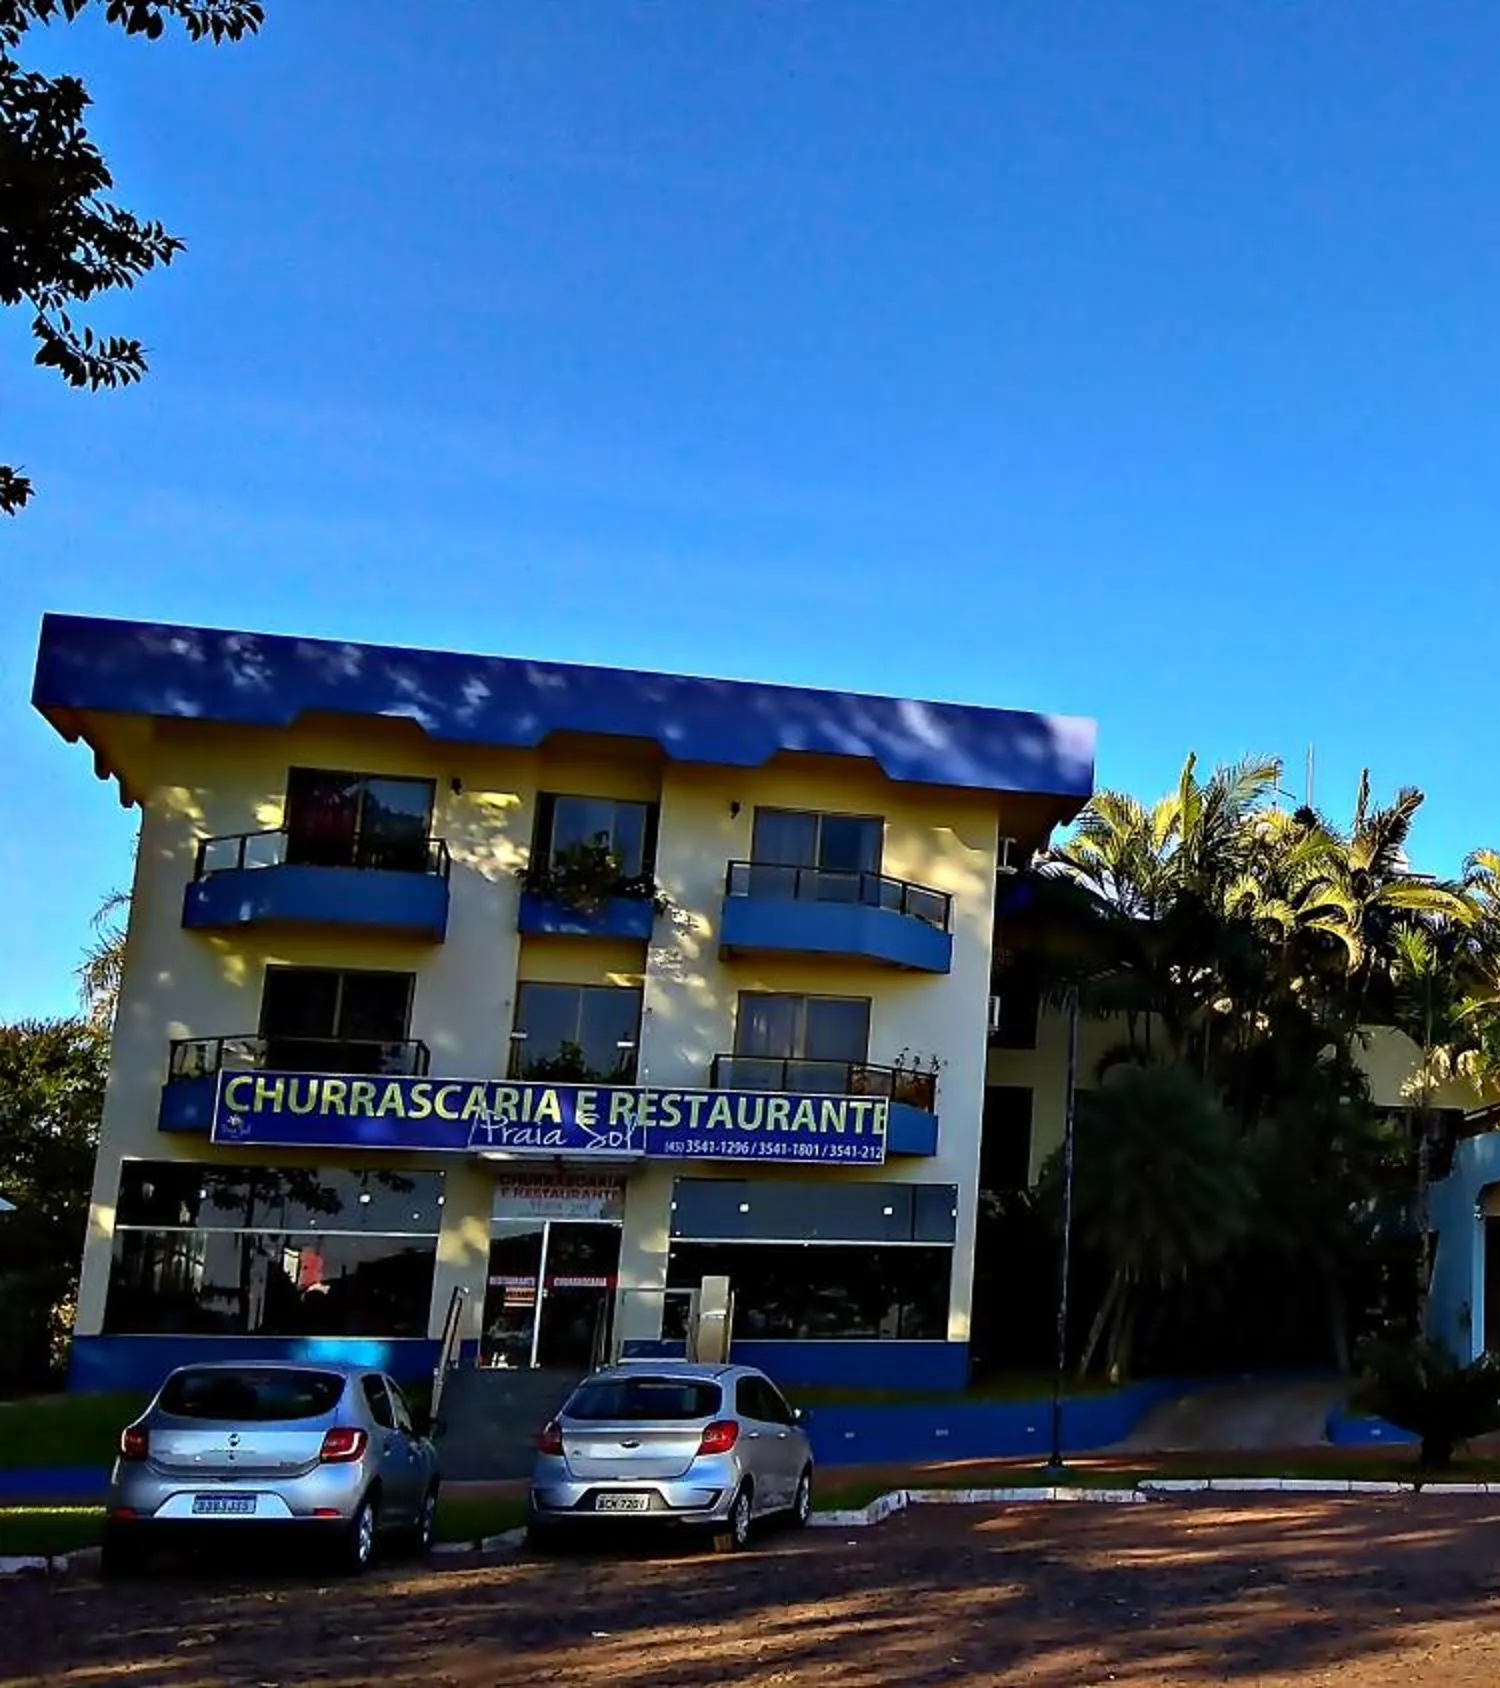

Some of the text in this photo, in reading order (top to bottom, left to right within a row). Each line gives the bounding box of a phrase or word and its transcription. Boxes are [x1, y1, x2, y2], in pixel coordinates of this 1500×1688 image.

[224, 1076, 886, 1136] CHURRASCARIA E RESTAURANTE
[479, 1109, 639, 1151] Praia Sol
[686, 1139, 750, 1154] 3541-1296
